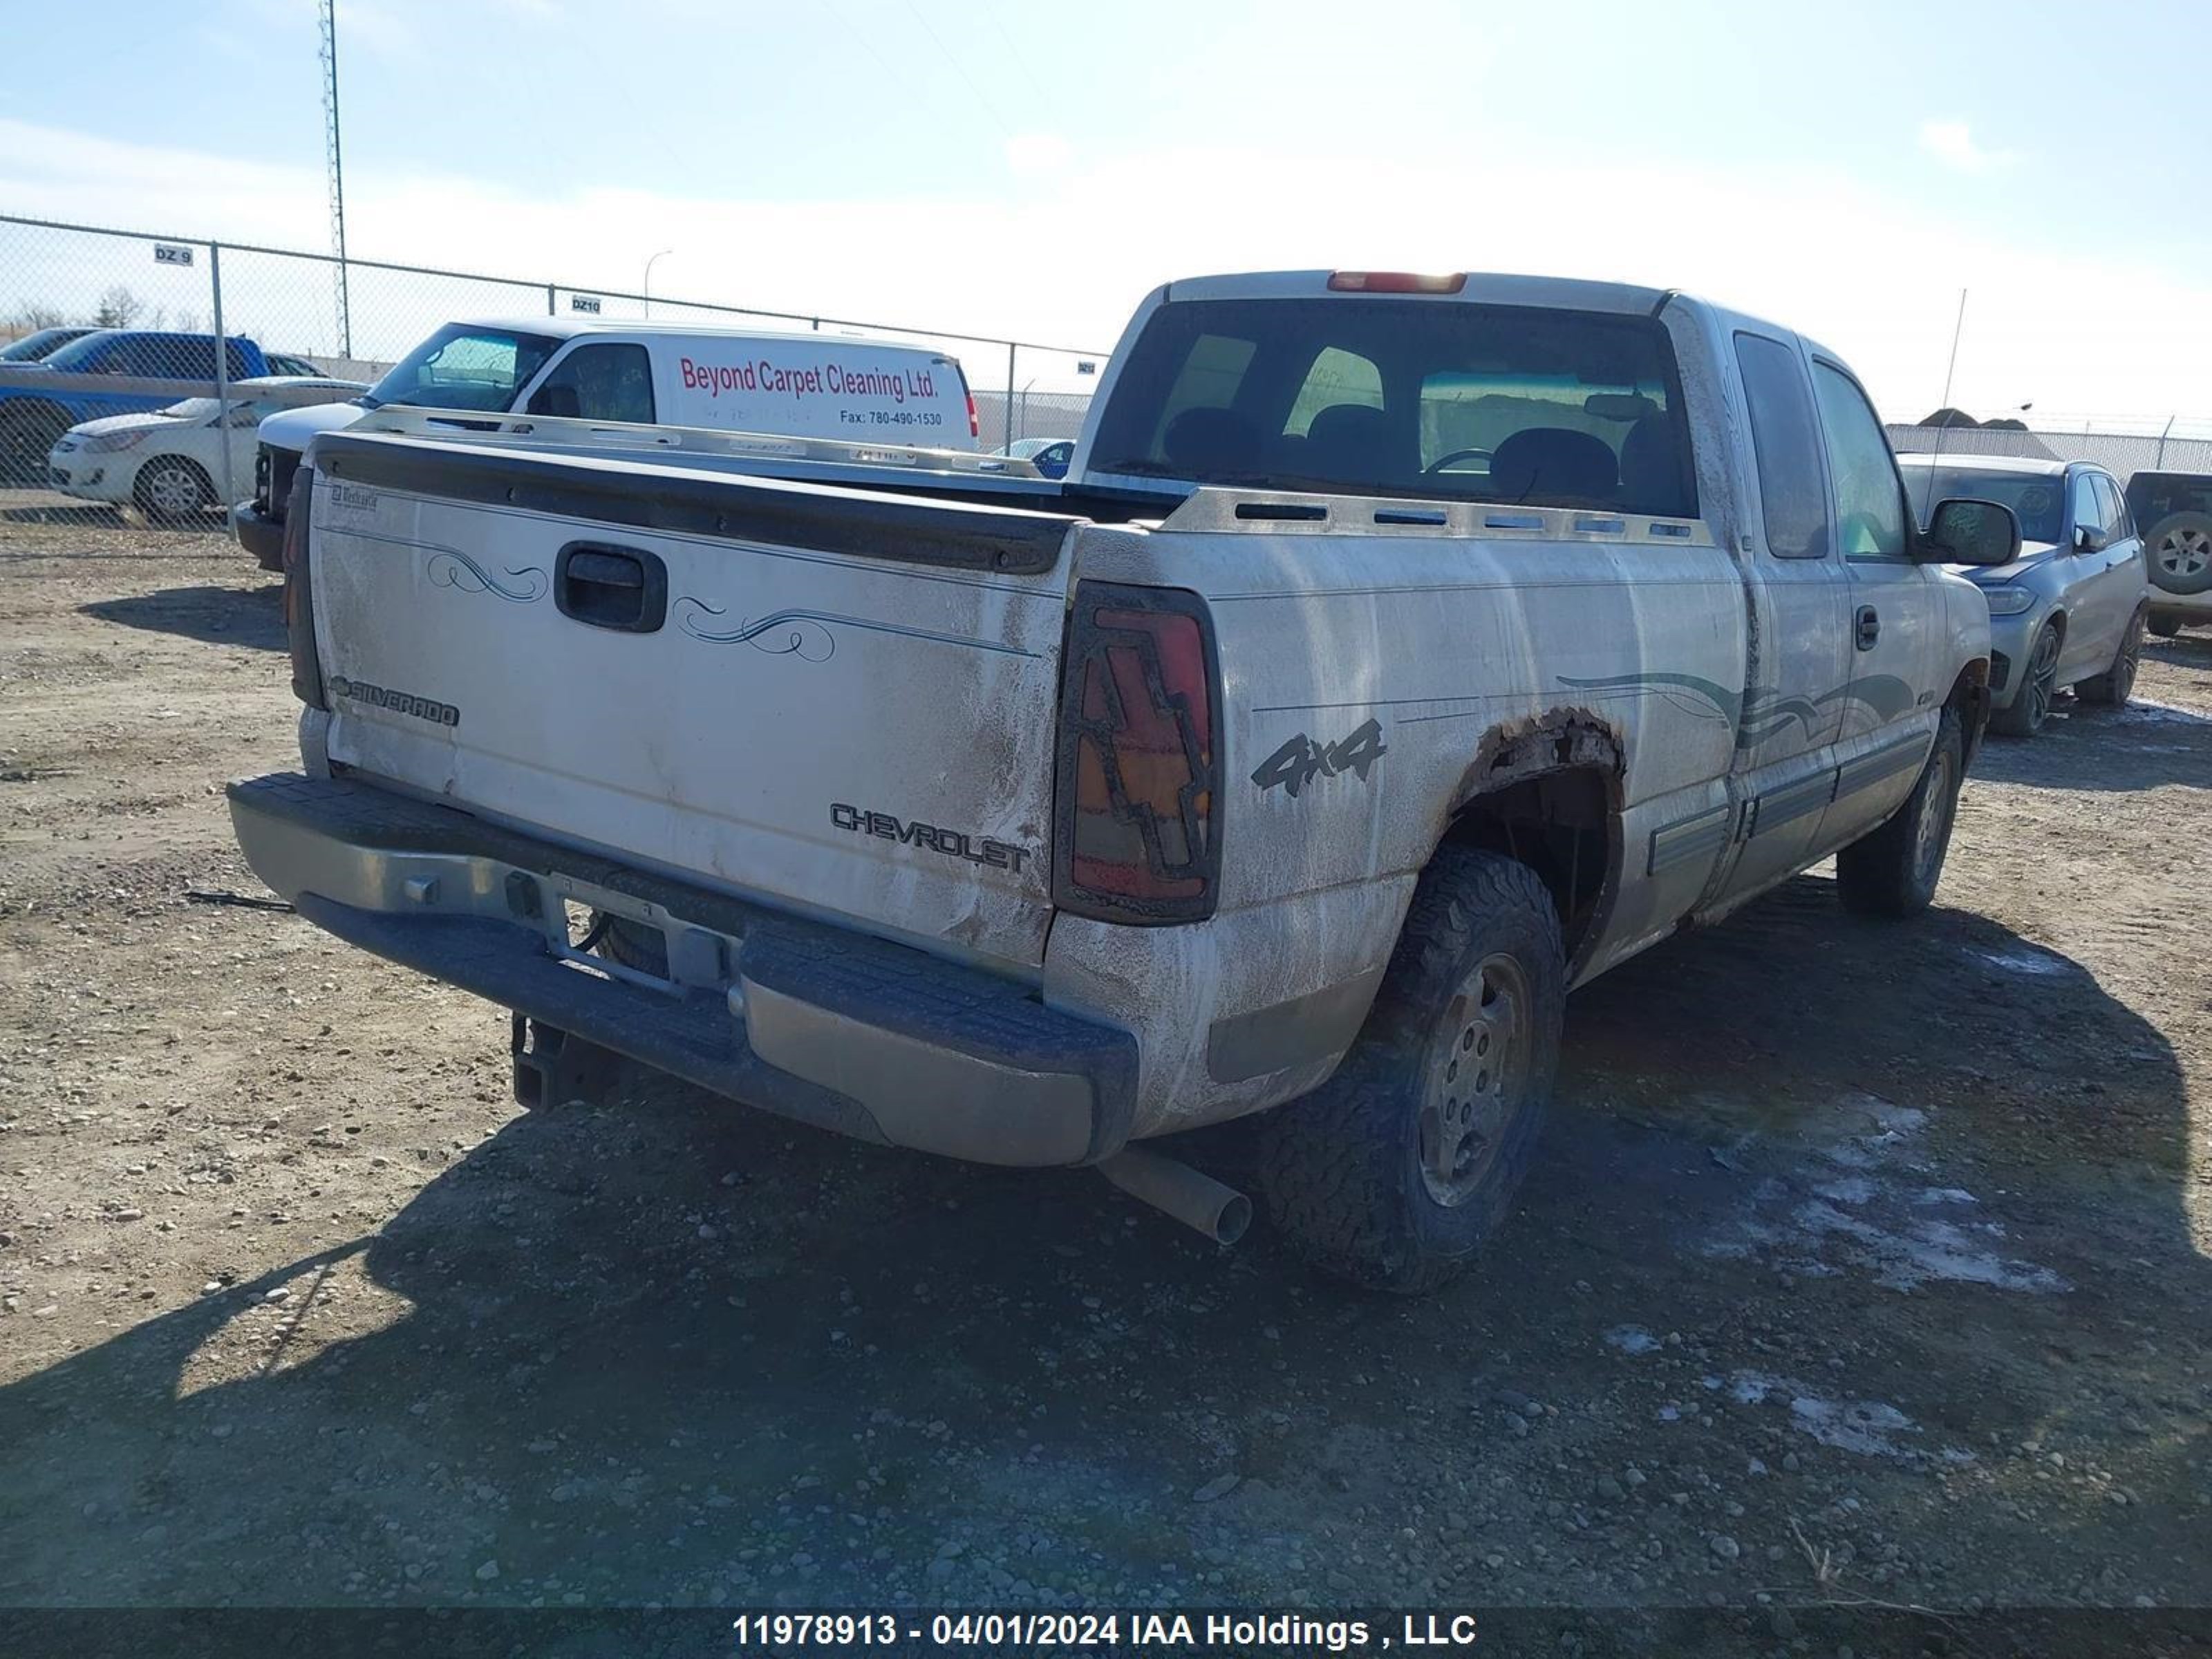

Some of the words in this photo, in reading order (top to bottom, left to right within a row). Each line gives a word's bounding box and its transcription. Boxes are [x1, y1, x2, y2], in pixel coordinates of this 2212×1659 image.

[156, 248, 177, 261] DZ
[181, 251, 189, 263] 9
[573, 299, 600, 312] DZ10
[681, 357, 756, 398] Beyond
[760, 361, 824, 400] Carpet
[827, 364, 905, 404] Cleaning
[906, 368, 939, 398] Ltd.
[840, 410, 866, 424] Fax:
[868, 411, 942, 426] 780-490-1530
[350, 680, 461, 727] SILVERADO
[1250, 718, 1387, 798] 4x4
[830, 803, 1031, 874] CHEVROLET
